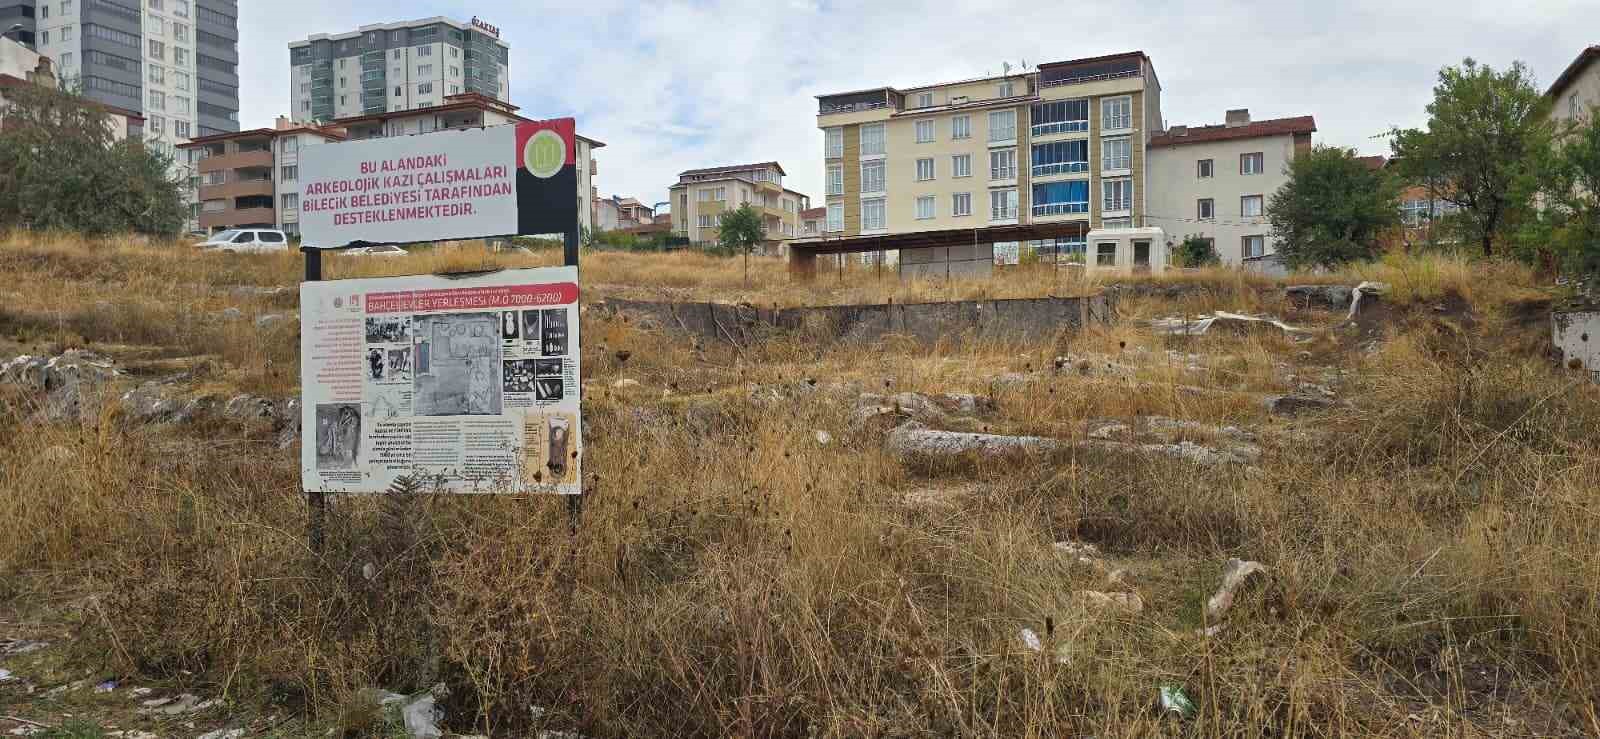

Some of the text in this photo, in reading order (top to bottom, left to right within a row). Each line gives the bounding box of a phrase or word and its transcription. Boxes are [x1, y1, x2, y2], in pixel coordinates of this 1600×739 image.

[361, 154, 447, 174] BU ALANDAKİ
[306, 165, 508, 196] ARKEOLOJİK KAZI ÇALIŞMALARI
[303, 183, 512, 212] BİLECİK BELEDİYESİ TARAFINDAN
[334, 203, 477, 226] DESTEKLENMEKTEDİR.
